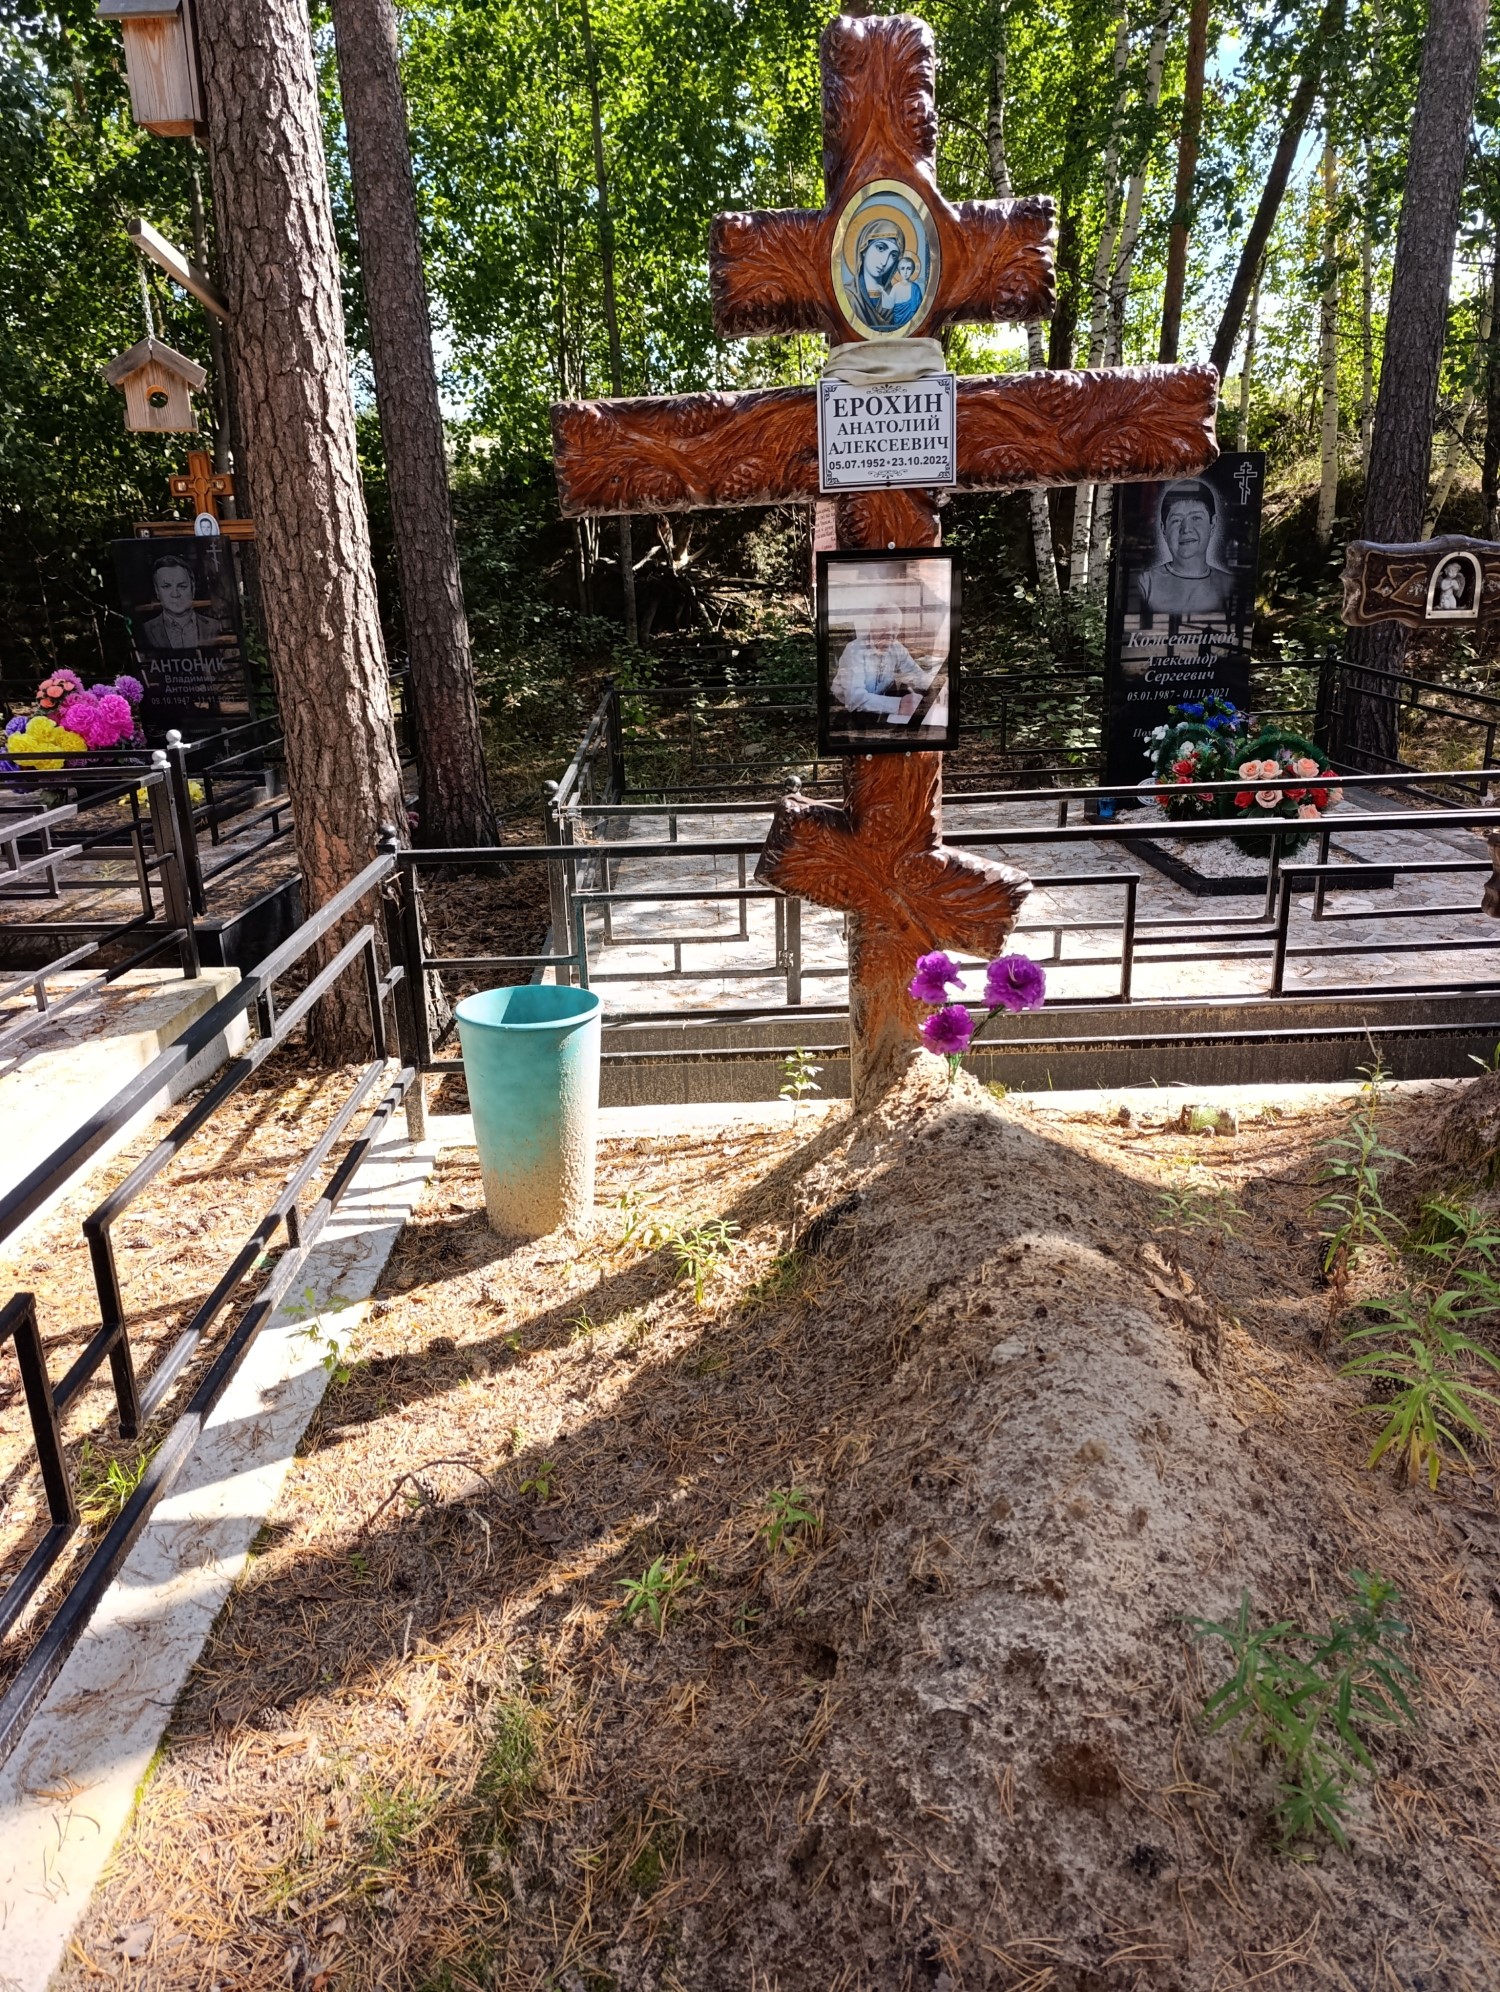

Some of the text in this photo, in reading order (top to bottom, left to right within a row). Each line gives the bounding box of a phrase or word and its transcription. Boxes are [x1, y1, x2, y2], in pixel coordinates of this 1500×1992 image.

[833, 393, 943, 417] ЕРОХИН
[837, 414, 940, 435] АНАТОЛИЙ
[828, 436, 949, 455] АЛЕКСЕЕВИЧ
[1127, 632, 1237, 648] Кожевников
[150, 658, 226, 673] АНТОНИК
[1146, 653, 1218, 667] Александр
[164, 674, 216, 684] Владимир
[1144, 671, 1215, 685] Сергеевич
[1127, 690, 1175, 701] 05.01.1987
